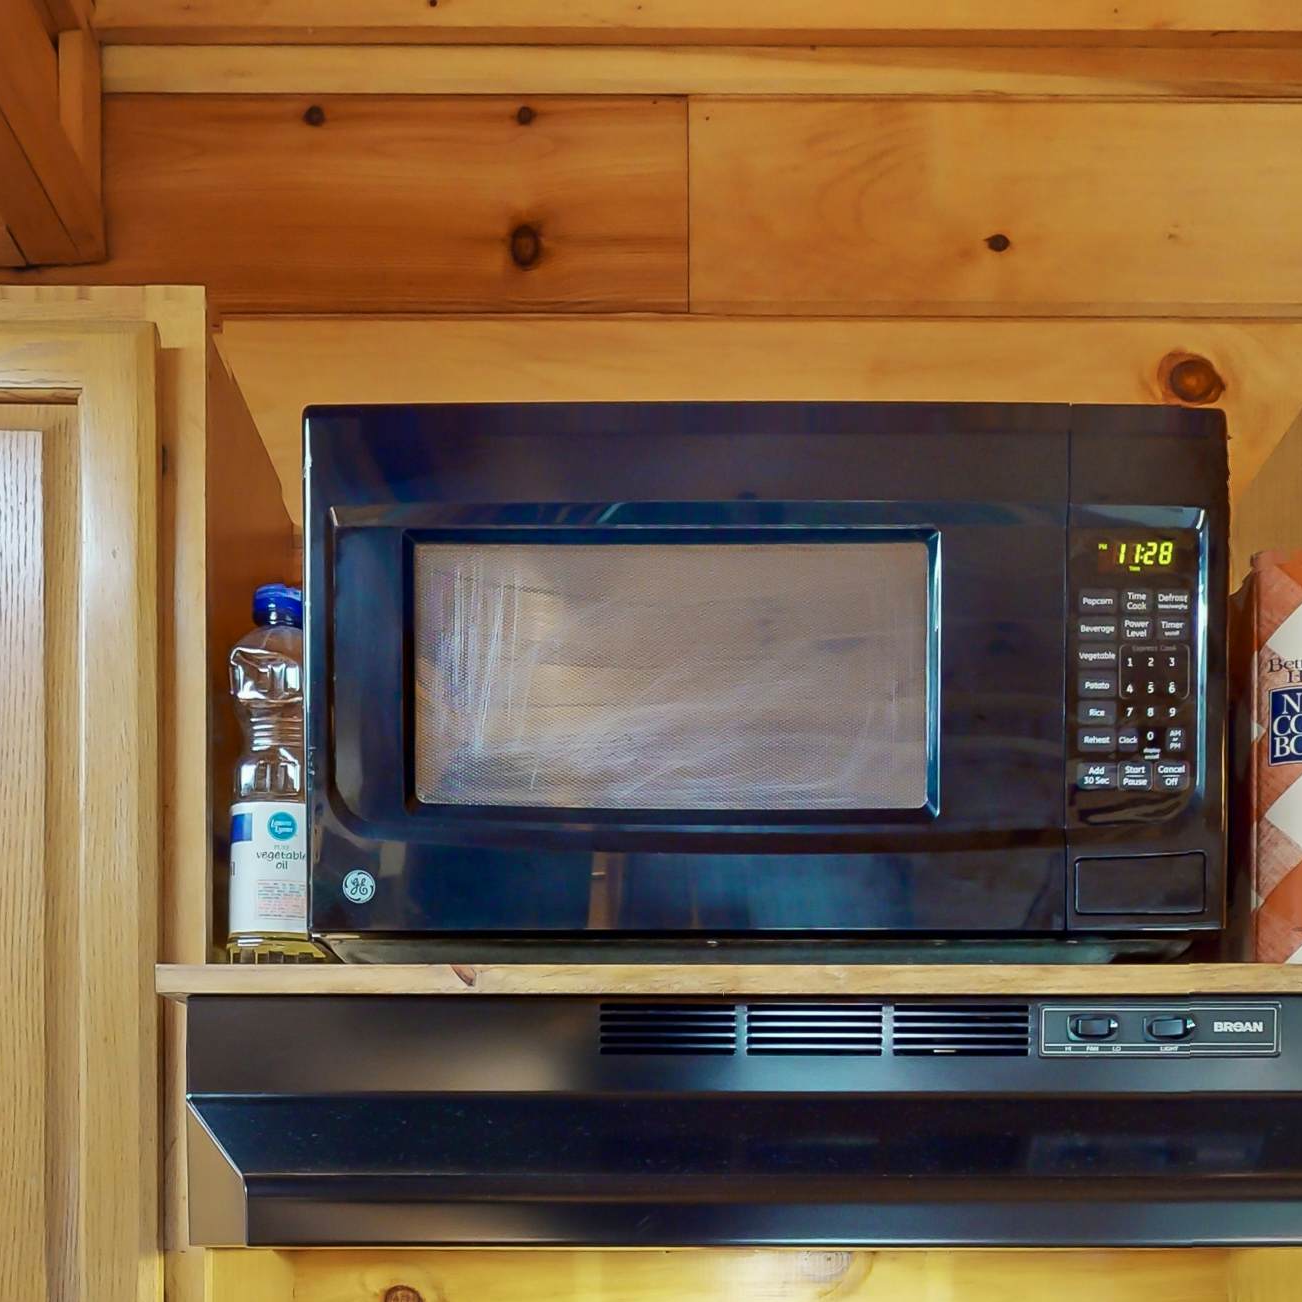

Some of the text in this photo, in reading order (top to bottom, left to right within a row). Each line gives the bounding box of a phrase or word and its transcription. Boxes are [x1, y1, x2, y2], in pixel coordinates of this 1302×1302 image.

[1118, 542, 1173, 565] 11:28
[1127, 592, 1146, 600] Time
[1158, 593, 1188, 602] Defrost
[1082, 597, 1113, 606] Popcorn
[1126, 602, 1147, 610] Cook
[1124, 619, 1149, 628] Power
[1161, 621, 1184, 629] Timer
[1080, 624, 1115, 634] Beverage
[1126, 629, 1147, 638] Level
[1079, 651, 1116, 661] Vegetable
[1127, 657, 1175, 667] 1 2 3
[1084, 682, 1110, 690] Potato
[1126, 684, 1176, 694] 4 5 6
[1126, 707, 1176, 717] 7 8 9
[1118, 736, 1138, 744] Clock
[1146, 731, 1154, 741] 0
[1088, 766, 1105, 775] Add
[1125, 765, 1146, 774] Start
[1158, 765, 1186, 774] Cancel
[1084, 776, 1110, 785] 30 Sec
[1123, 777, 1148, 786] Pause
[1165, 777, 1179, 786] Off
[275, 861, 289, 870] oil
[1213, 1021, 1264, 1033] BROAN
